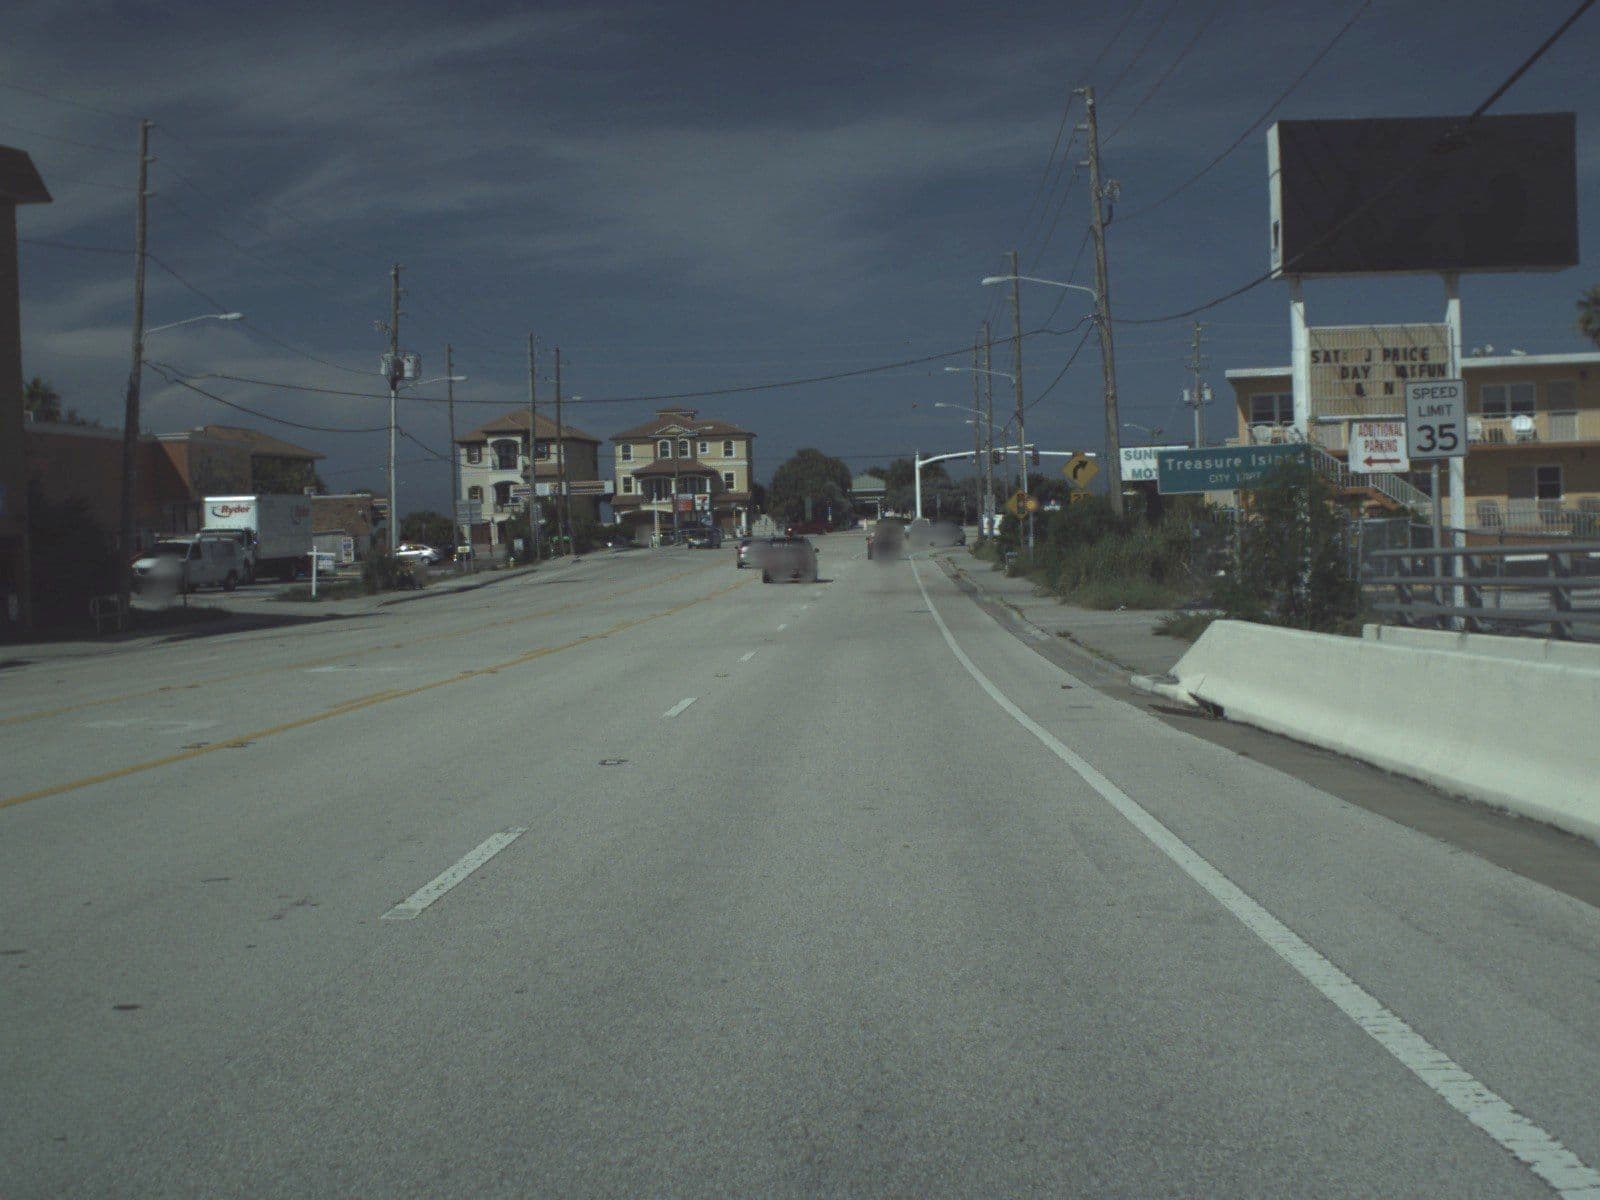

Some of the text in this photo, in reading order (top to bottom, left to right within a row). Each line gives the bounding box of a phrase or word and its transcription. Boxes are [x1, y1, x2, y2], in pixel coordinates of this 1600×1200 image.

[1341, 365, 1371, 380] DAY
[1412, 386, 1458, 400] SPEED
[1418, 404, 1453, 417] LIMIT
[1417, 423, 1459, 452] 35
[1364, 439, 1398, 453] PARKING
[1165, 456, 1242, 471] Treasure
[221, 505, 251, 514] Ryder
